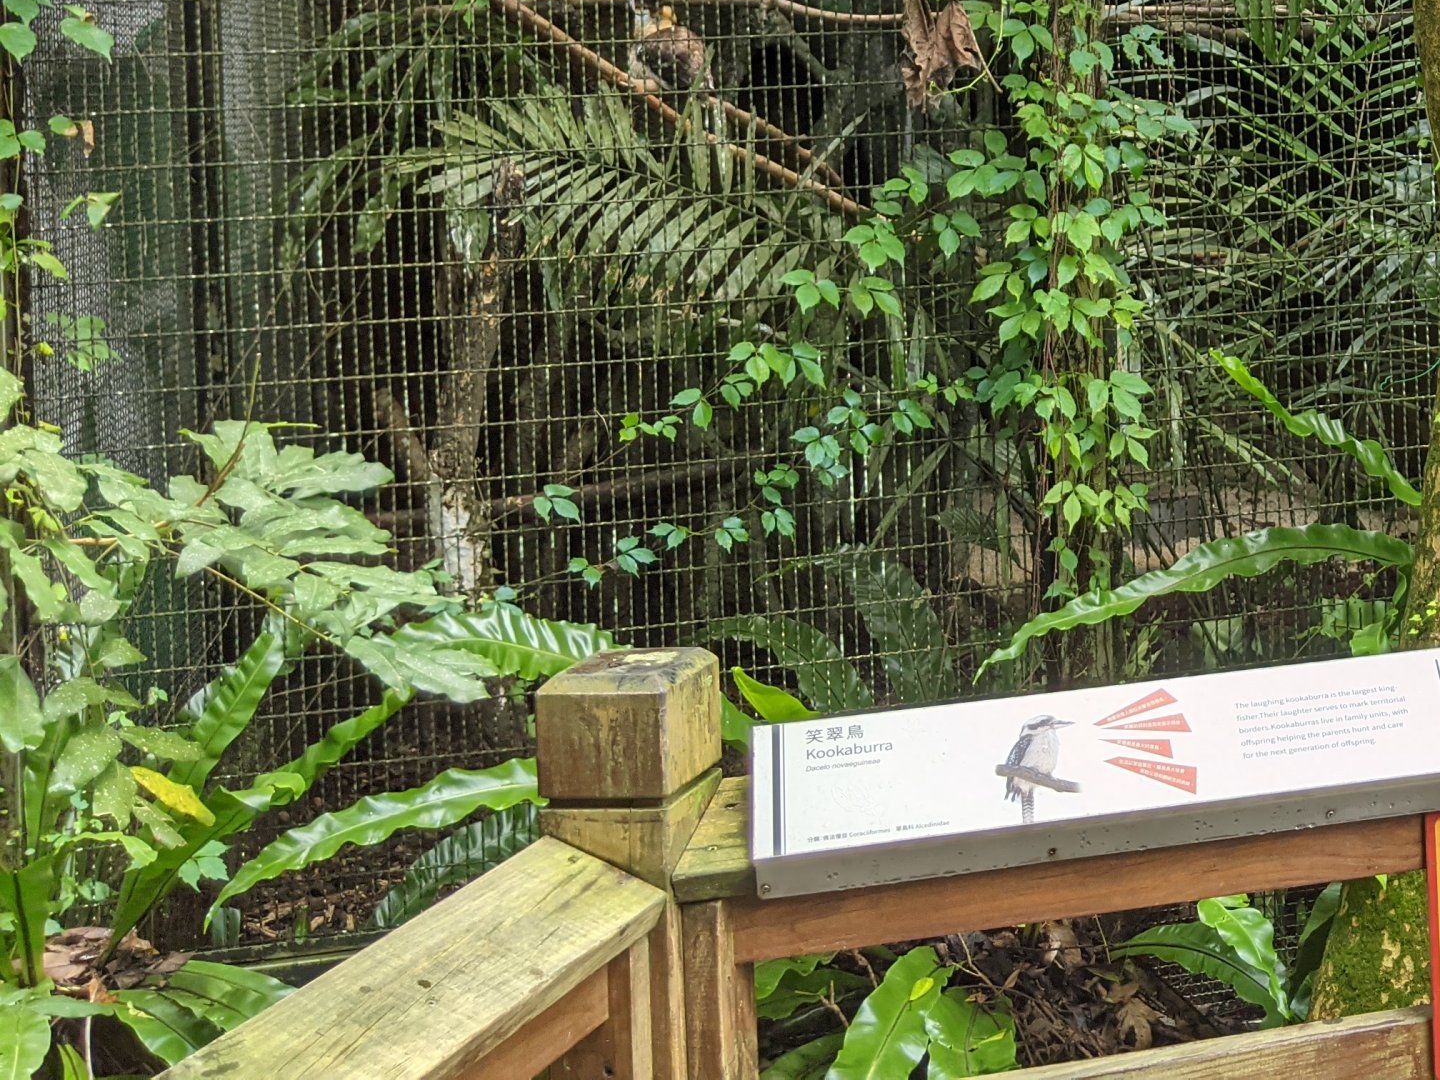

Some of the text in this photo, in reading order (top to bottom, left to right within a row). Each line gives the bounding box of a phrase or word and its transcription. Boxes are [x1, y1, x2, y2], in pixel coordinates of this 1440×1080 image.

[1235, 702, 1249, 710] The
[1251, 697, 1284, 707] laughing
[1286, 692, 1329, 703] kookaburra
[1338, 688, 1350, 697] the
[1352, 687, 1377, 696] largest
[1281, 706, 1312, 717] laughter
[1314, 704, 1338, 712] serves
[1340, 702, 1348, 710] to
[1349, 700, 1368, 708] mark
[1370, 696, 1406, 706] territorial
[1321, 716, 1334, 724] live
[1345, 712, 1368, 722] family
[1370, 711, 1390, 719] units,
[1392, 708, 1409, 716] with
[806, 725, 863, 744] 笑翠鳥
[1241, 736, 1275, 747] offspring
[1277, 732, 1306, 743] helping
[1307, 730, 1320, 738] the
[1322, 728, 1350, 738] parents
[1352, 724, 1370, 733] hunt
[1372, 723, 1386, 731] and
[806, 742, 893, 760] Kookaburra
[1256, 750, 1269, 758] the
[1270, 748, 1286, 756] next
[1289, 743, 1330, 755] generation
[1331, 741, 1339, 749] of
[806, 764, 830, 772] Dacelo
